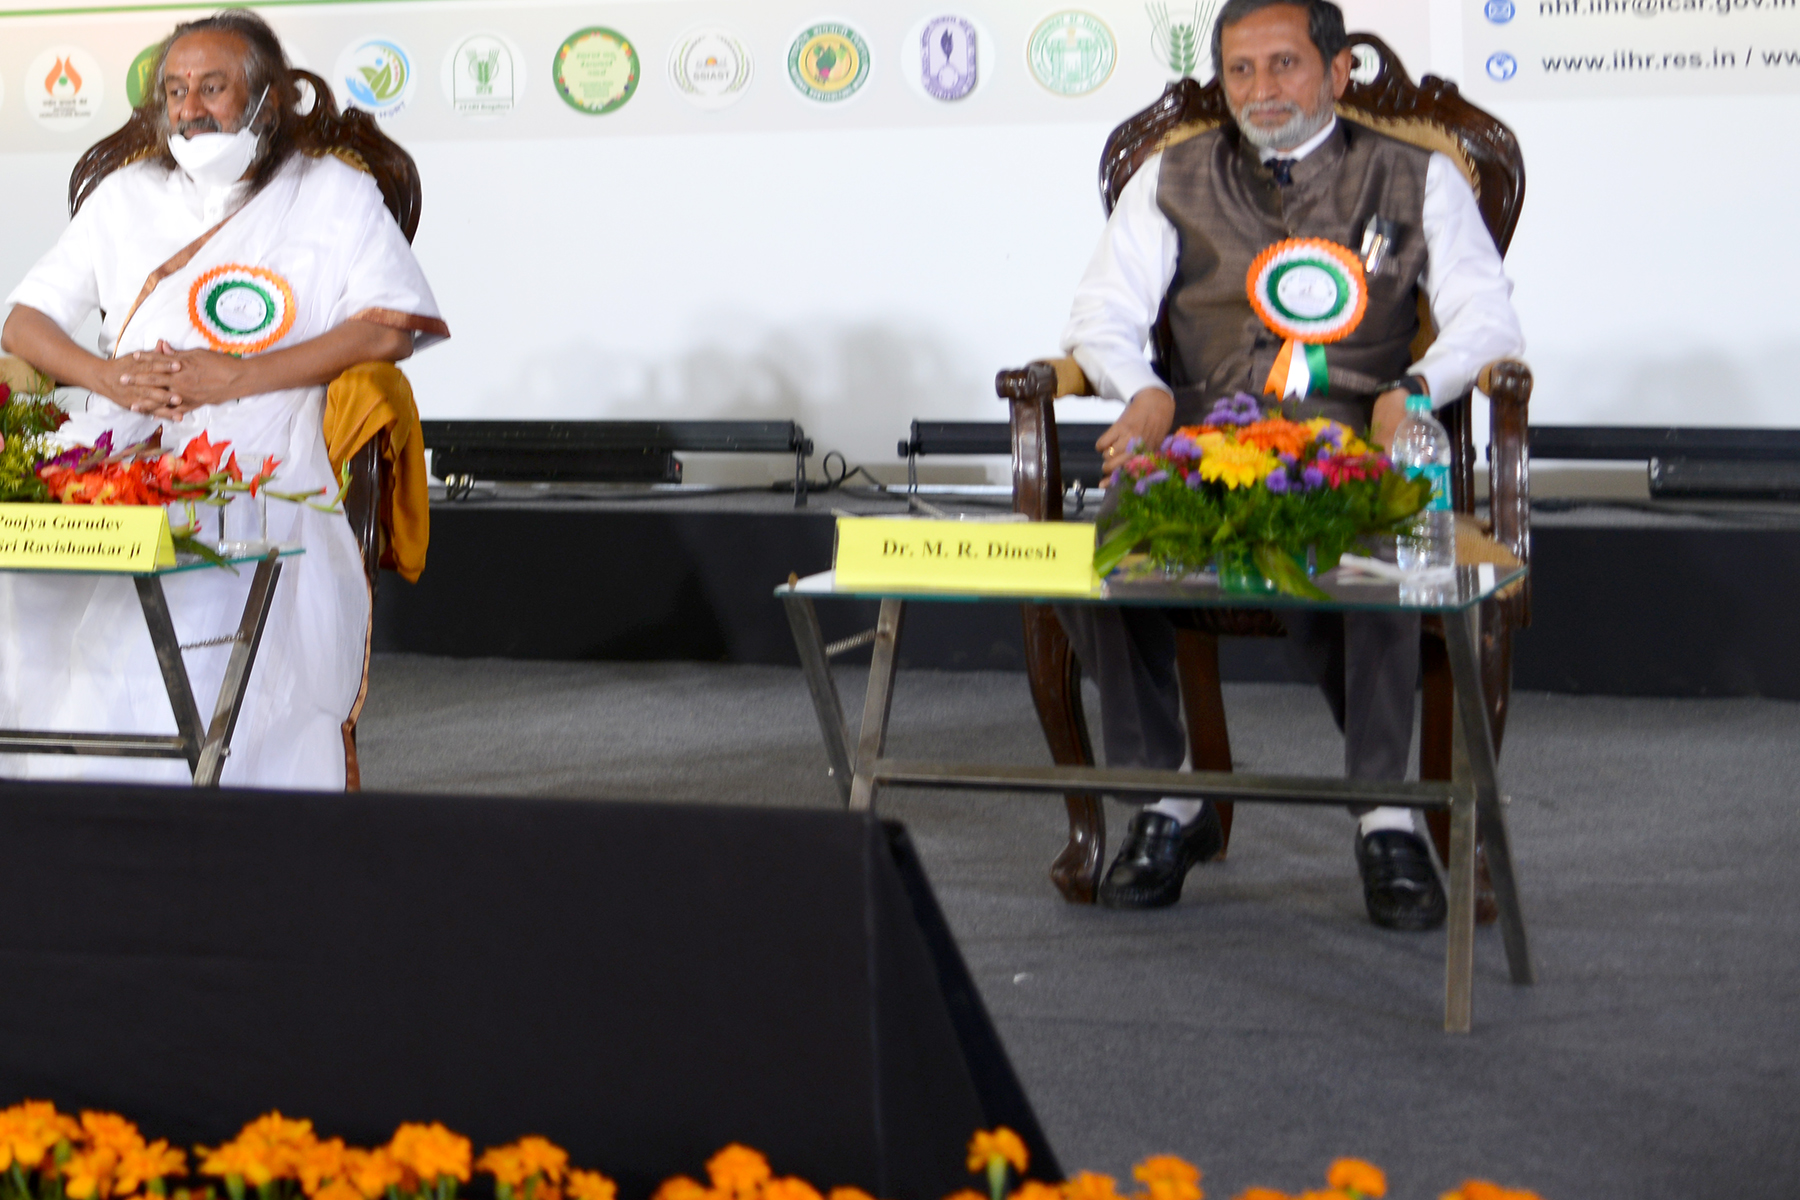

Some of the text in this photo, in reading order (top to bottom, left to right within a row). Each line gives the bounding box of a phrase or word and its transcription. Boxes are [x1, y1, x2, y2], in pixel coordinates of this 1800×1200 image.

[1542, 46, 1735, 72] www.iihr.res.in
[52, 514, 123, 531] Gurudev
[22, 540, 124, 556] Ravishankar
[128, 542, 141, 560] ji
[883, 539, 1057, 561] Dr. M. R. Dinesh
